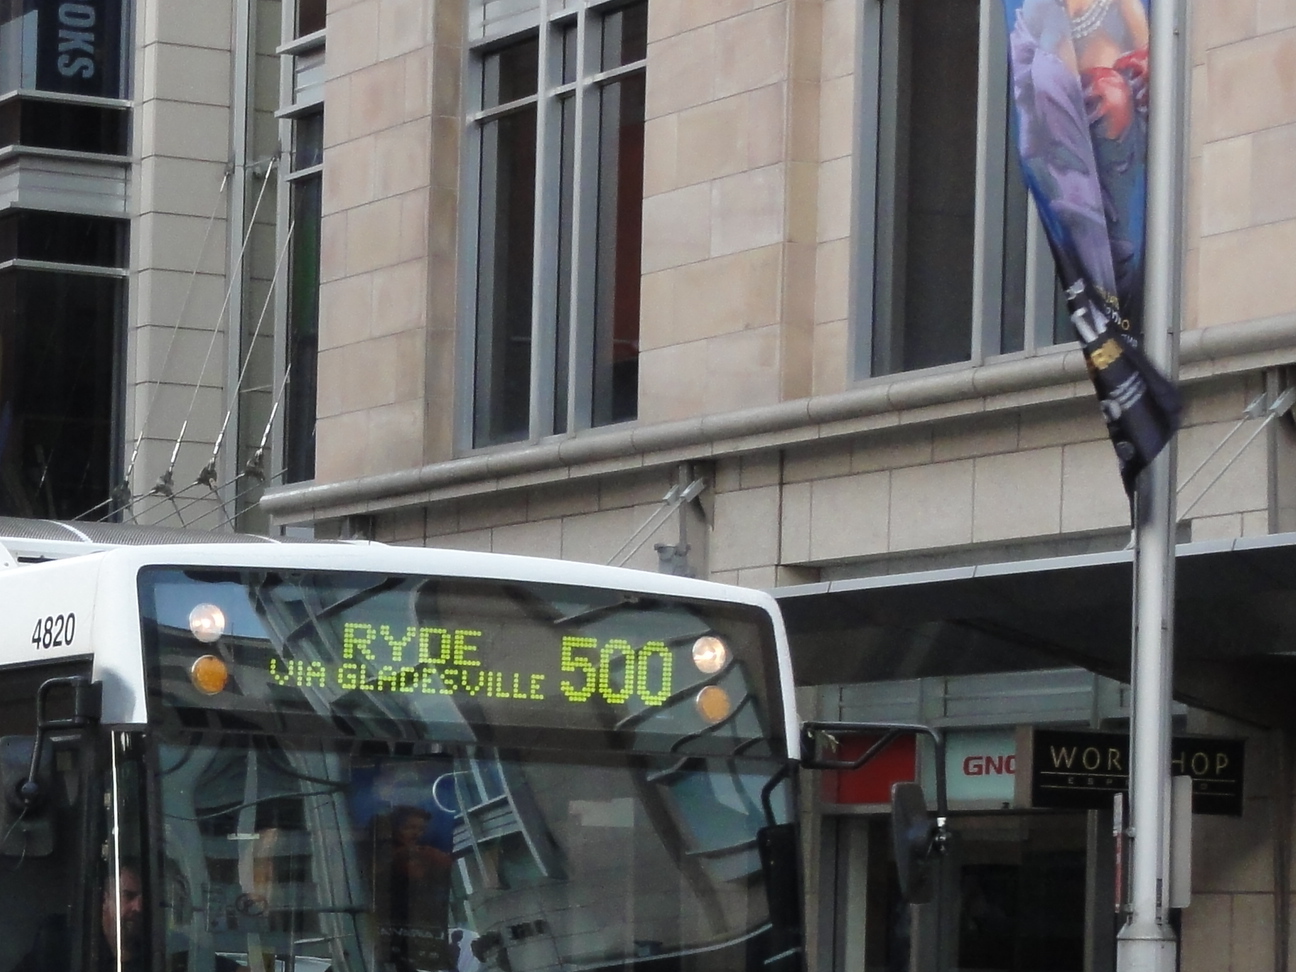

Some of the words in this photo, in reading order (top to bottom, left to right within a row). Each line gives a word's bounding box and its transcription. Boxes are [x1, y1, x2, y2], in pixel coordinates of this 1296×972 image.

[31, 612, 76, 650] 4820
[344, 623, 482, 667] RYDE
[270, 659, 326, 689] VIA
[337, 663, 545, 700] GLADESVILLE
[561, 636, 674, 706] 500
